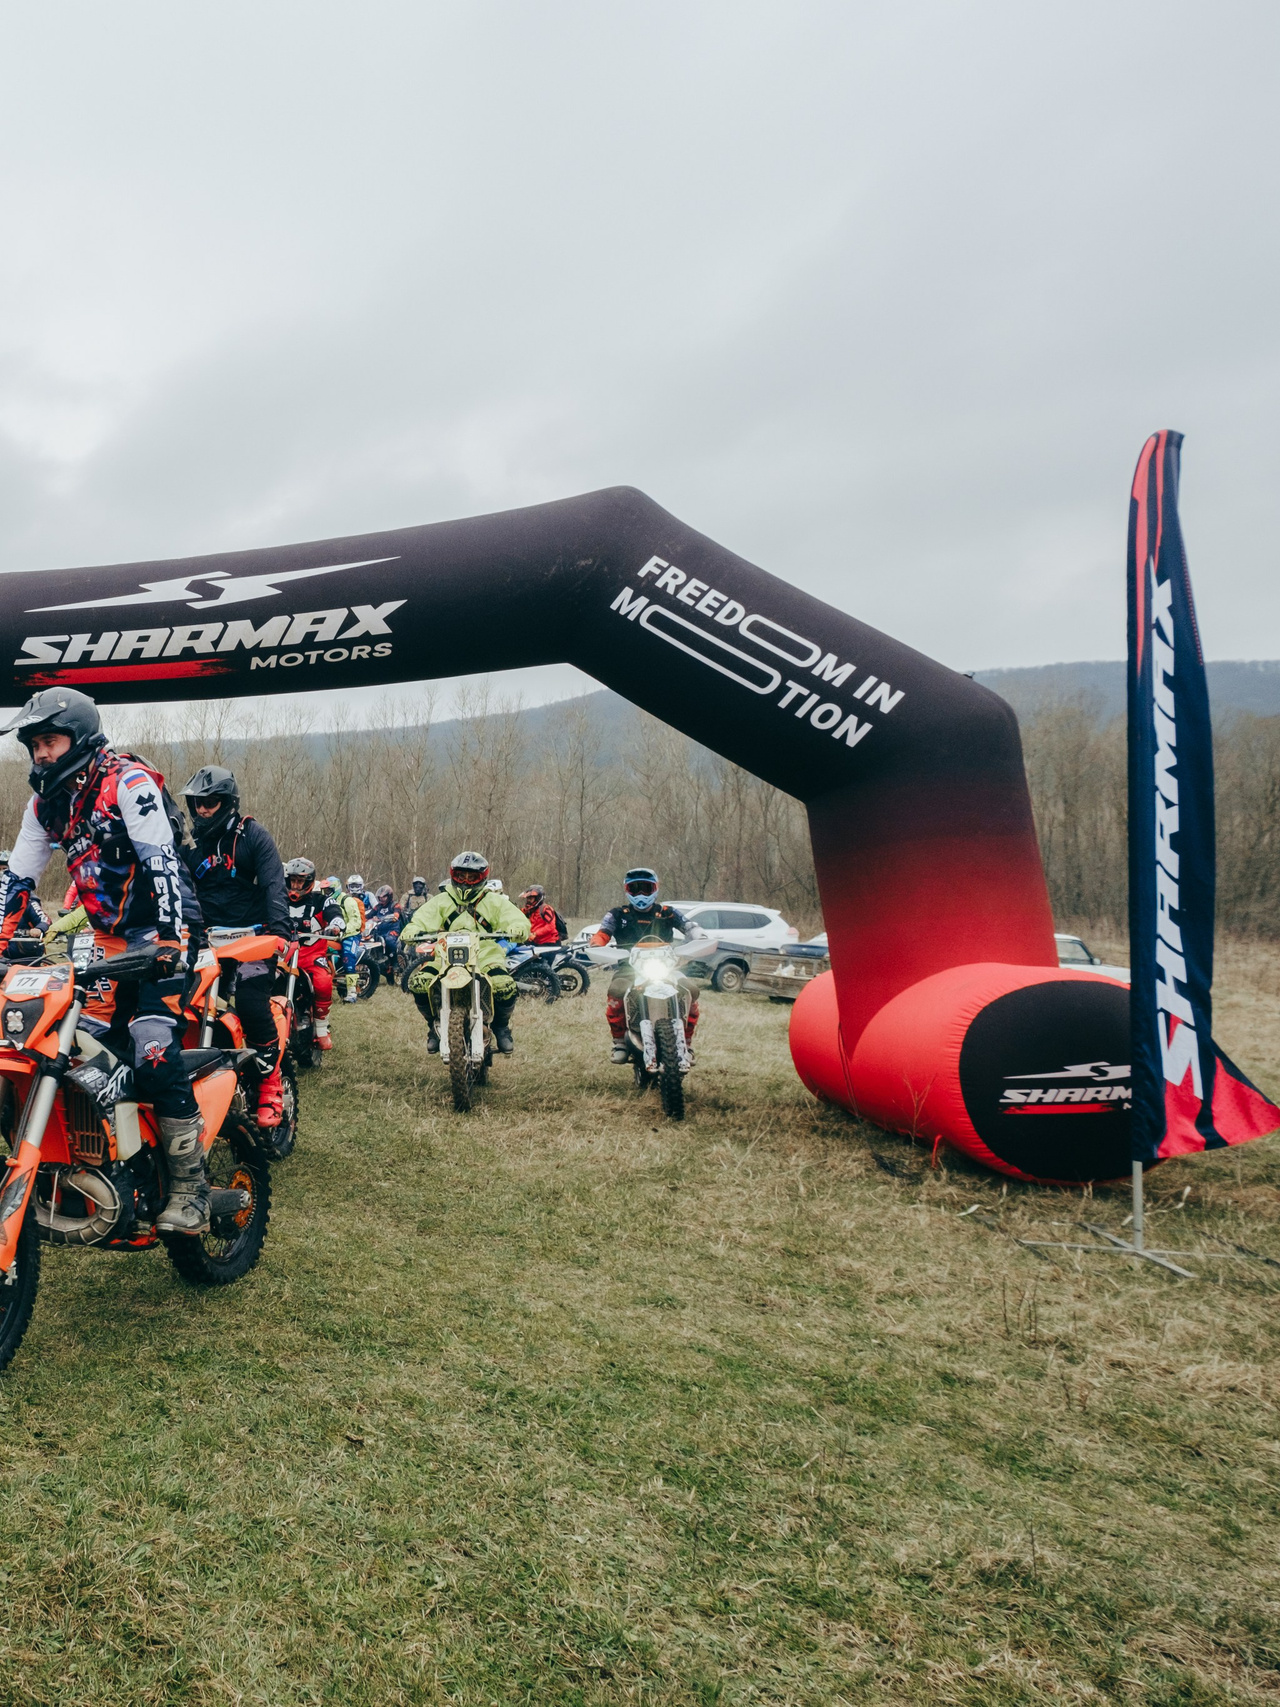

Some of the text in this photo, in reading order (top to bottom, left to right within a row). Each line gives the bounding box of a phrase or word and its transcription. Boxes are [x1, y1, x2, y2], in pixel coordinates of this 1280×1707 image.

[14, 600, 408, 666] SHARMAX
[250, 642, 393, 671] MOTORS
[610, 586, 873, 748] MOTION
[637, 555, 906, 714] FREEDOM IN
[1150, 555, 1204, 1100] SHARMAX
[16, 976, 40, 987] 171
